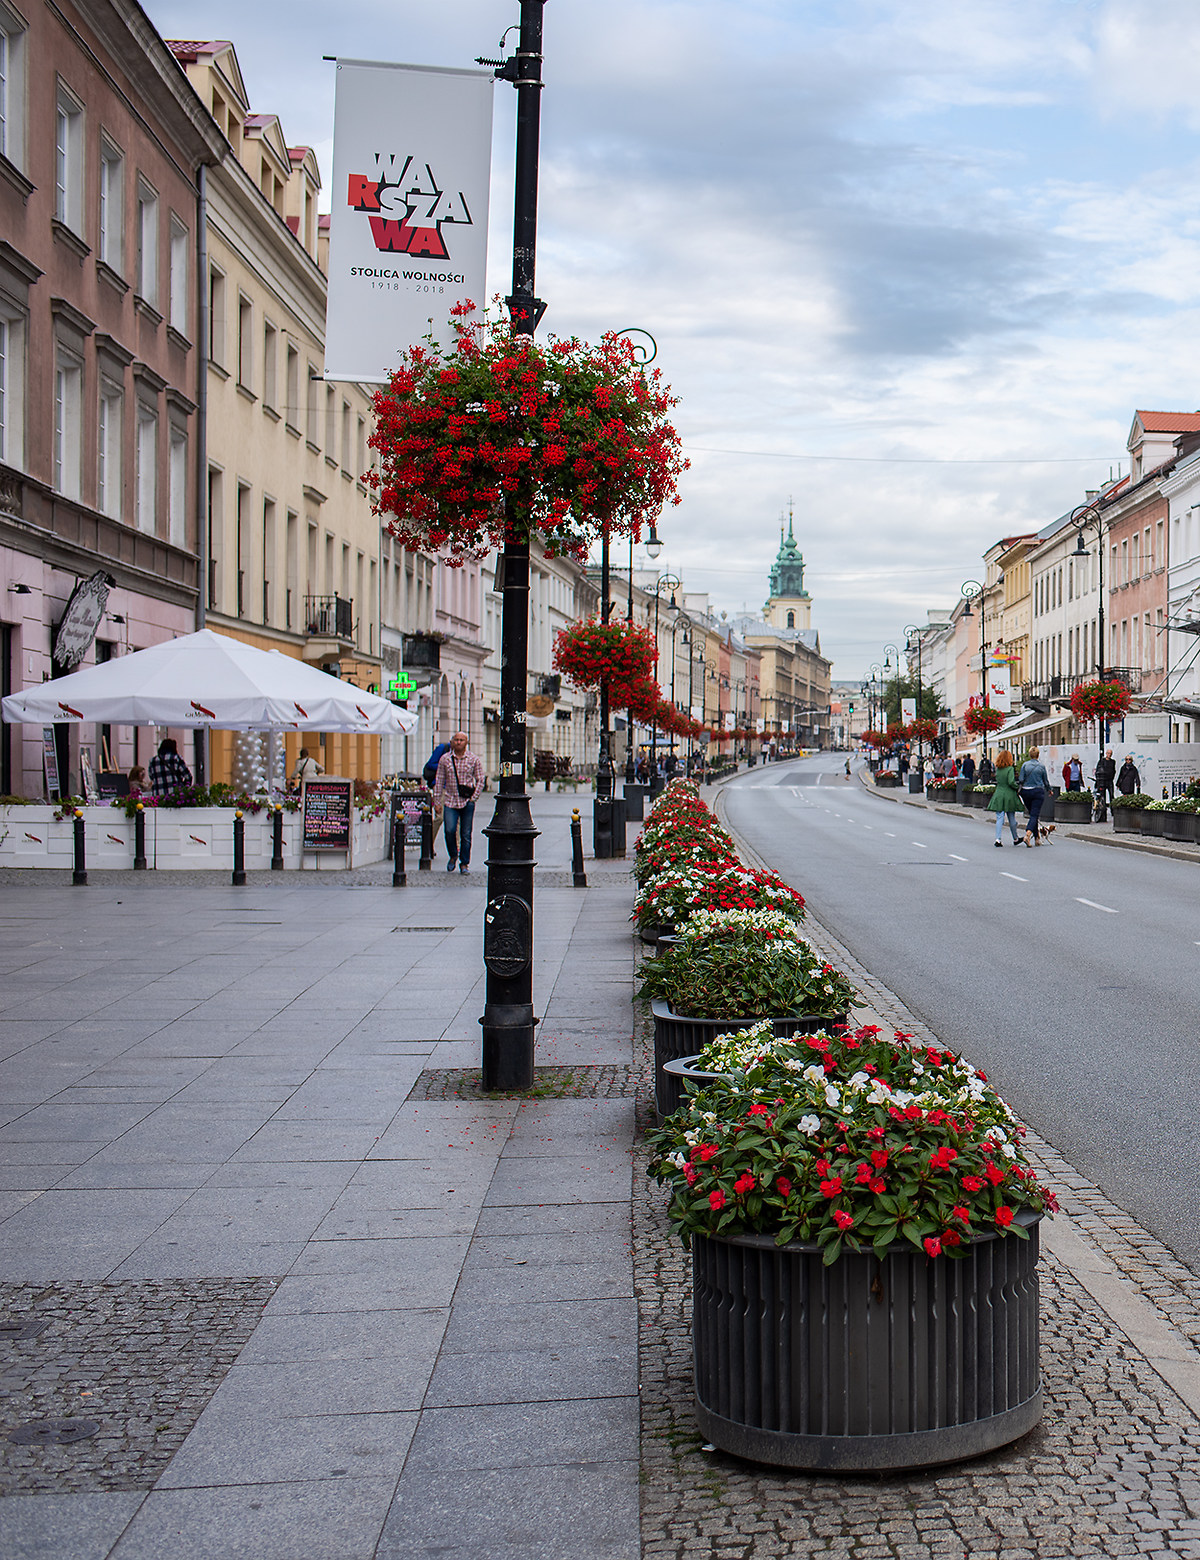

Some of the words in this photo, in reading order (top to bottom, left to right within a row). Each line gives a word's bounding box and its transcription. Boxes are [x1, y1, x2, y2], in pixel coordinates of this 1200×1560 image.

[367, 215, 451, 260] WA
[350, 267, 399, 279] STOLICA
[402, 270, 465, 284] WOLNOŚCI
[371, 281, 399, 291] 1918
[415, 284, 444, 294] 2018
